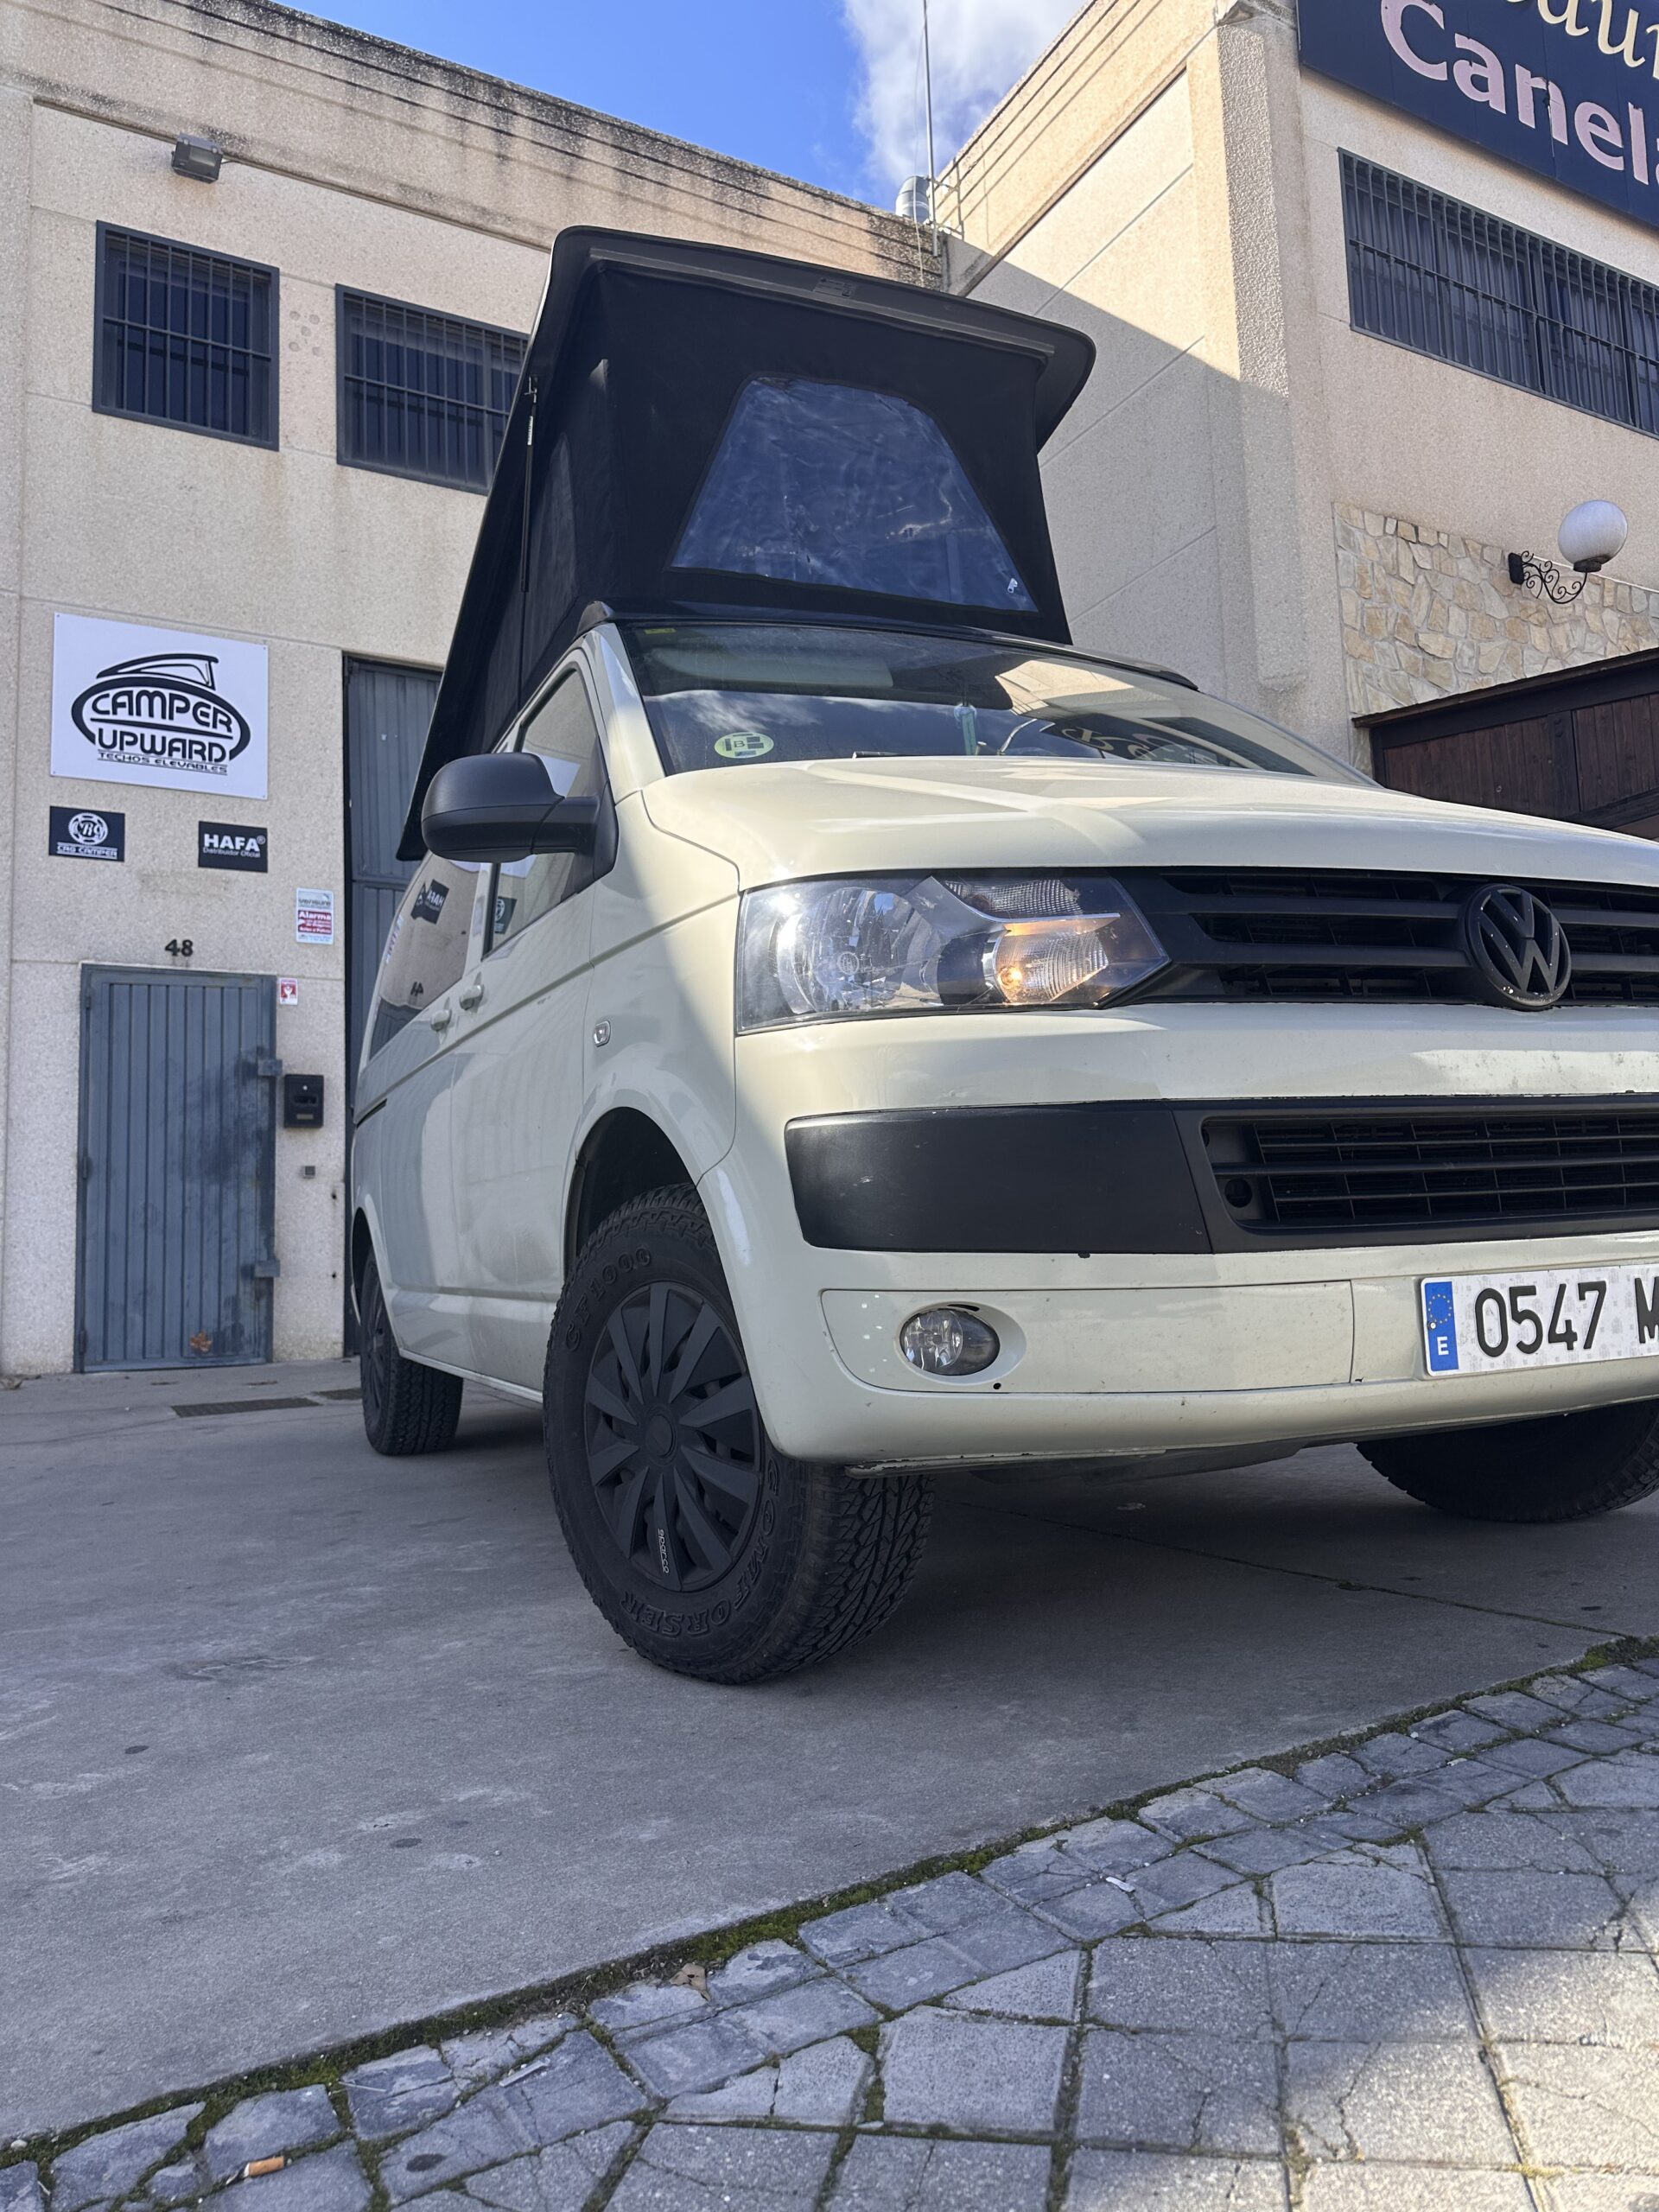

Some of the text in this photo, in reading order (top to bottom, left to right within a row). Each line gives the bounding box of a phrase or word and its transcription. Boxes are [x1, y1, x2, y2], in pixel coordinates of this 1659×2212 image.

[1381, 0, 1659, 186] Canel
[92, 690, 232, 733] CAMPER
[98, 728, 226, 763] UPWARD
[100, 752, 228, 773] TECHOS ELEVABLES
[165, 938, 194, 957] 48
[1437, 1336, 1449, 1356] E
[1474, 1280, 1607, 1358] 0547
